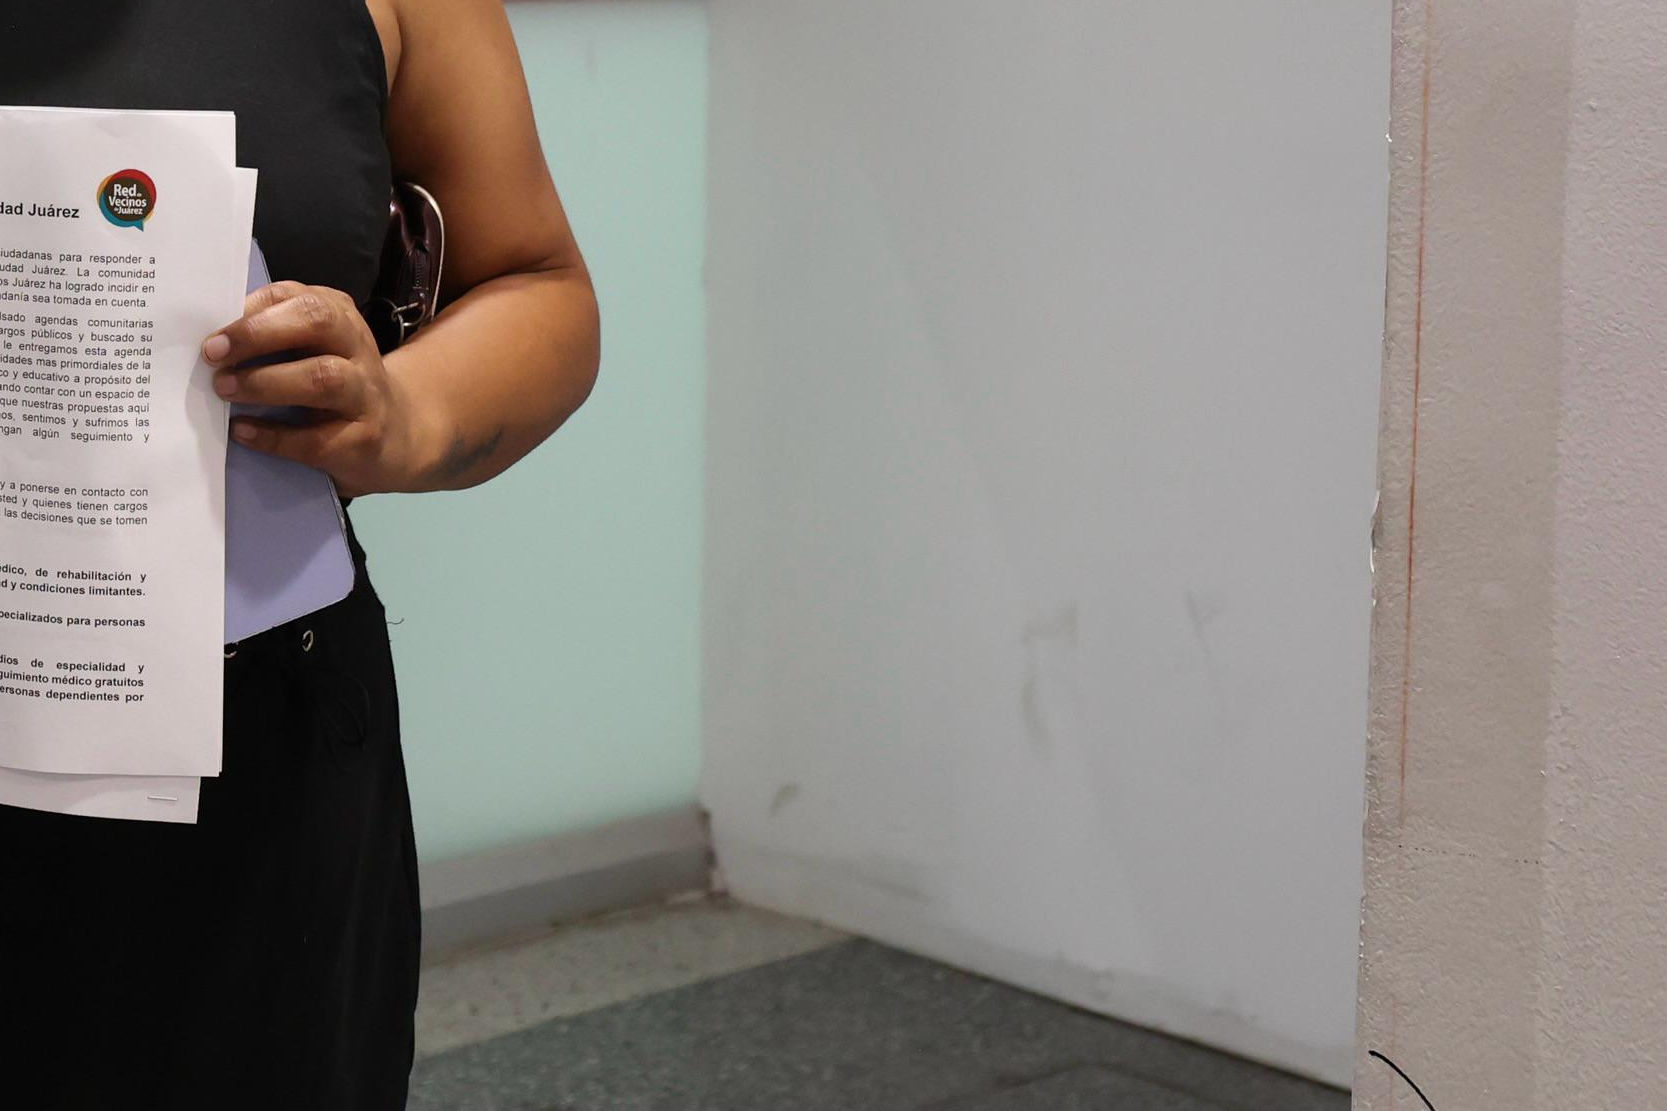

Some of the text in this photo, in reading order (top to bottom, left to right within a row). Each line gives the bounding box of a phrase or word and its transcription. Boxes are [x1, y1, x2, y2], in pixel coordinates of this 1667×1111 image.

[113, 184, 137, 197] Red
[108, 196, 147, 208] Vecinos
[28, 203, 80, 218] Juárez
[117, 206, 143, 215] Juárez
[59, 254, 82, 263] para
[89, 254, 142, 266] responder
[98, 269, 155, 278] comunidad
[12, 277, 47, 289] Juárez
[65, 280, 105, 294] logrado
[107, 281, 139, 293] incidir
[53, 294, 91, 306] tomada
[35, 316, 78, 327] agendas
[87, 318, 153, 328] comunitarias
[31, 328, 73, 340] públicos
[91, 331, 135, 343] buscado
[19, 342, 78, 355] entregamos
[85, 347, 107, 356] esta
[114, 346, 151, 359] agenda
[60, 359, 123, 371] primordiales
[22, 370, 70, 382] educativo
[84, 375, 132, 387] propósito
[23, 386, 55, 396] contar
[95, 389, 135, 401] espacio
[21, 399, 64, 411] nuestras
[67, 404, 124, 414] propuestas
[22, 414, 66, 424] sentimos
[85, 417, 129, 428] sufrimos
[33, 427, 59, 440] algún
[71, 431, 133, 443] seguimiento
[20, 483, 60, 494] ponerse
[81, 488, 125, 497] contacto
[32, 498, 72, 509] quienes
[77, 500, 109, 511] tienen
[113, 503, 148, 514] cargos
[21, 510, 74, 524] decisiones
[115, 516, 147, 525] tomen
[57, 570, 131, 581] rehabilitación
[19, 582, 85, 595] condiciones
[89, 586, 145, 596] limitantes.
[67, 618, 91, 627] para
[94, 618, 145, 628] personas
[56, 662, 125, 674] especialidad
[51, 674, 93, 686] médico
[94, 677, 144, 688] gratuitos
[45, 688, 120, 702] dependientes
[125, 692, 144, 704] por
